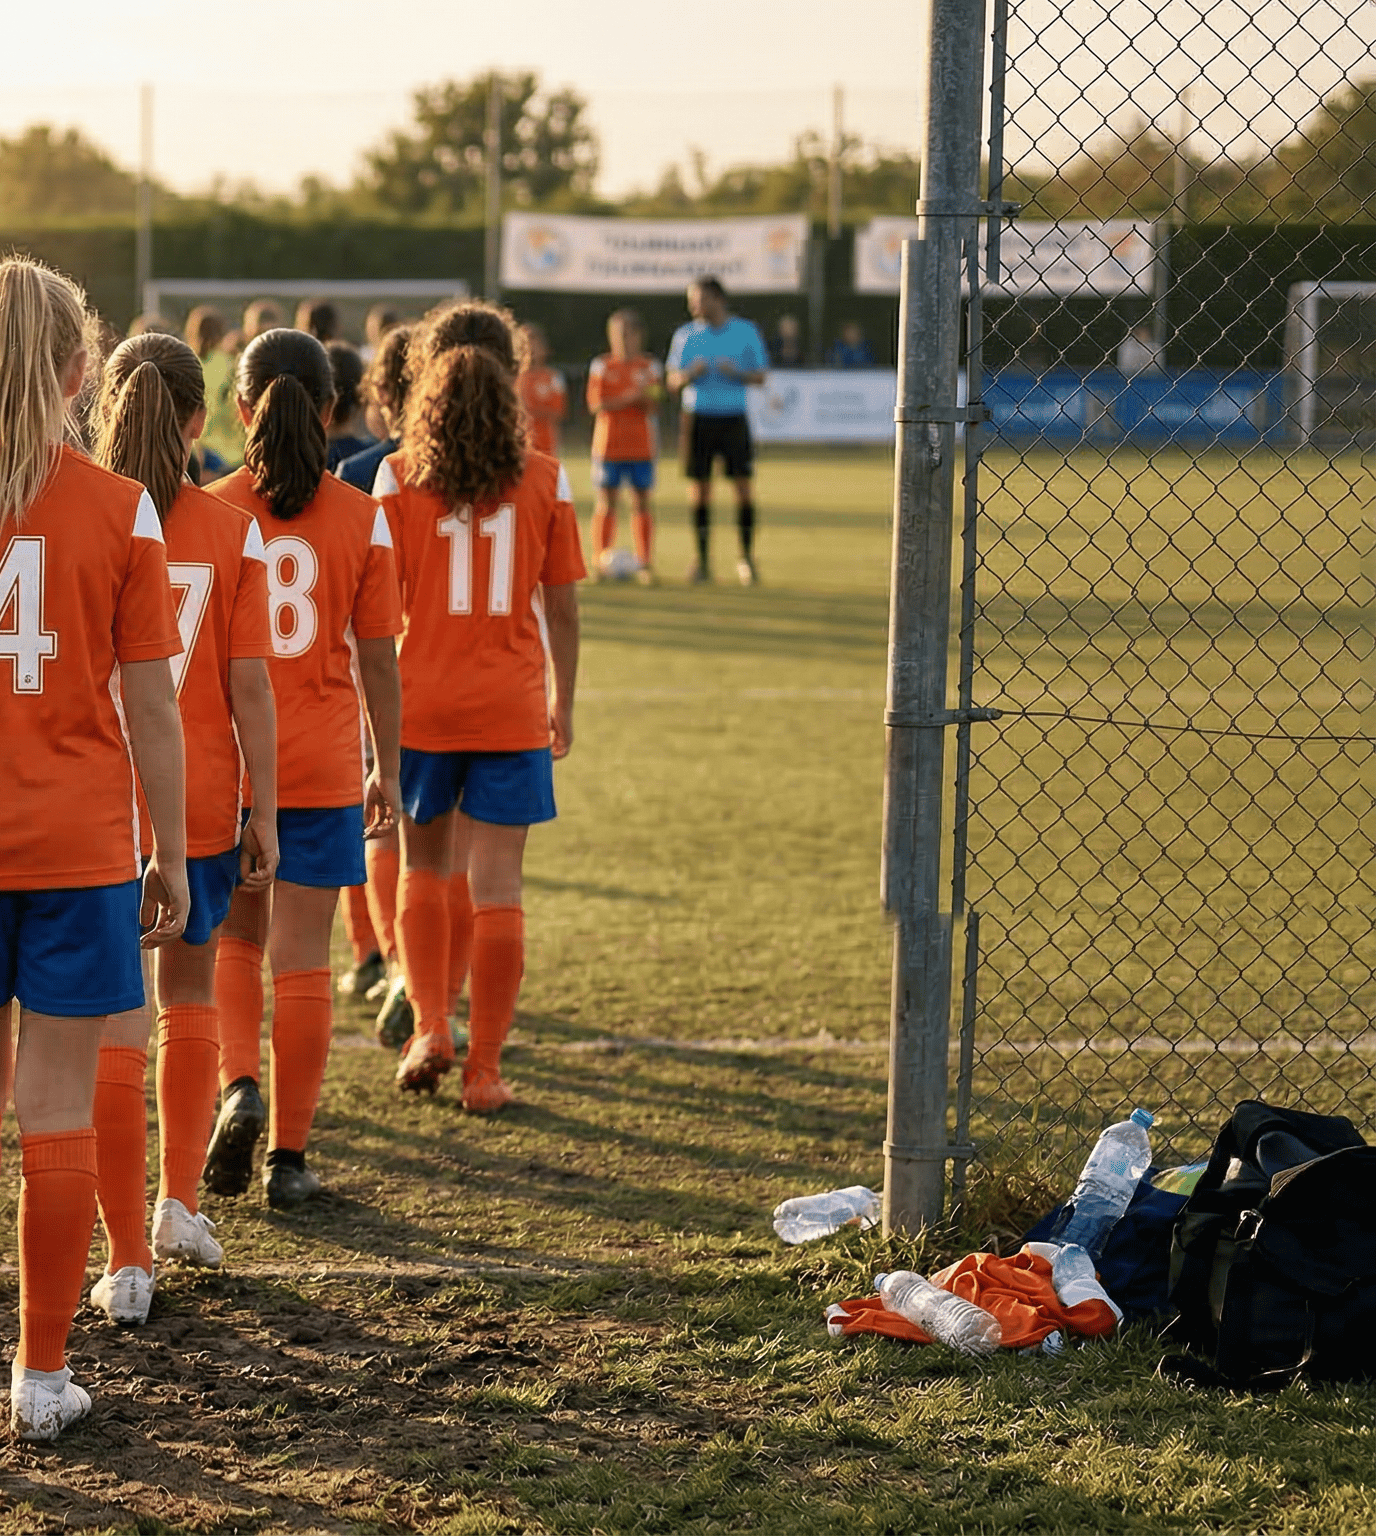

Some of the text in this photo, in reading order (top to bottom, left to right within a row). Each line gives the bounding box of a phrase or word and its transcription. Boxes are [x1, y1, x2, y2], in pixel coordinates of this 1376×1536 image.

[264, 536, 319, 659] 8
[437, 503, 516, 616] 11
[167, 562, 214, 701] 7
